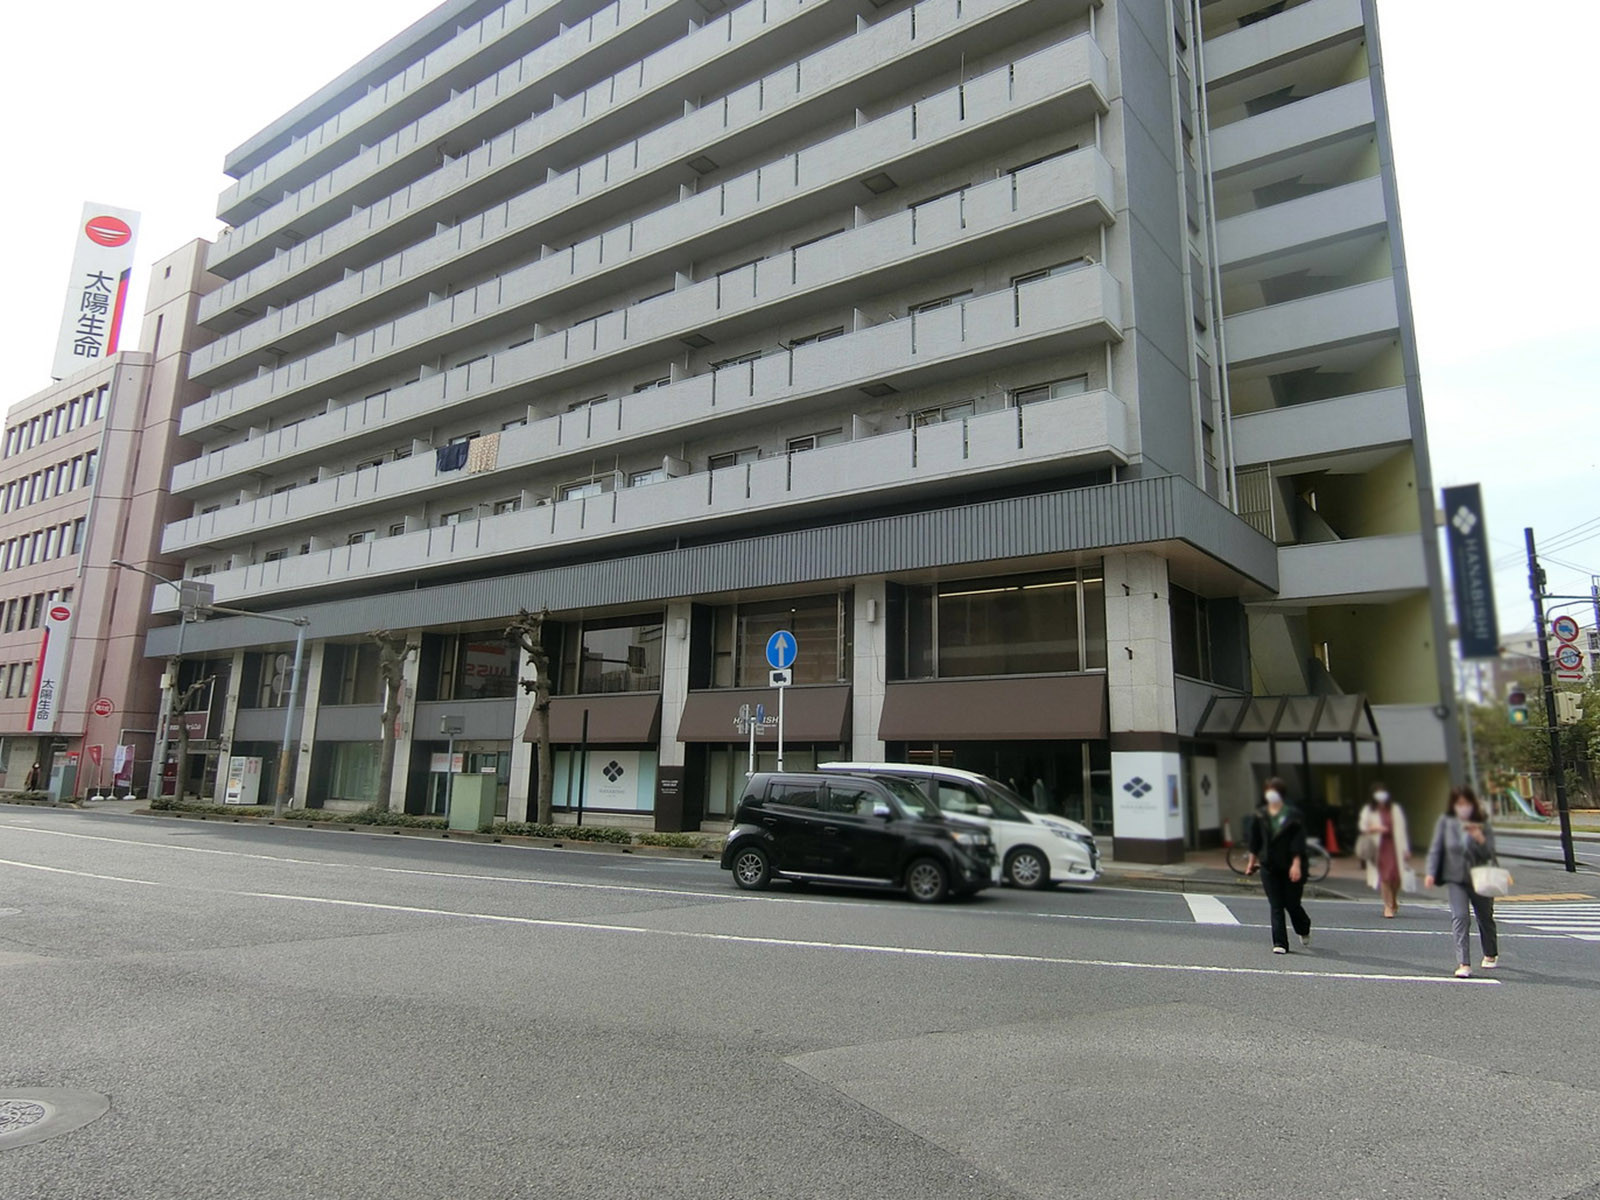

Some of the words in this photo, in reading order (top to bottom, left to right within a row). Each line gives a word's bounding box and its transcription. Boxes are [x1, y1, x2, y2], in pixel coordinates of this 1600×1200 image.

[73, 270, 114, 358] 太陽生命
[37, 679, 55, 720] 太陽生命
